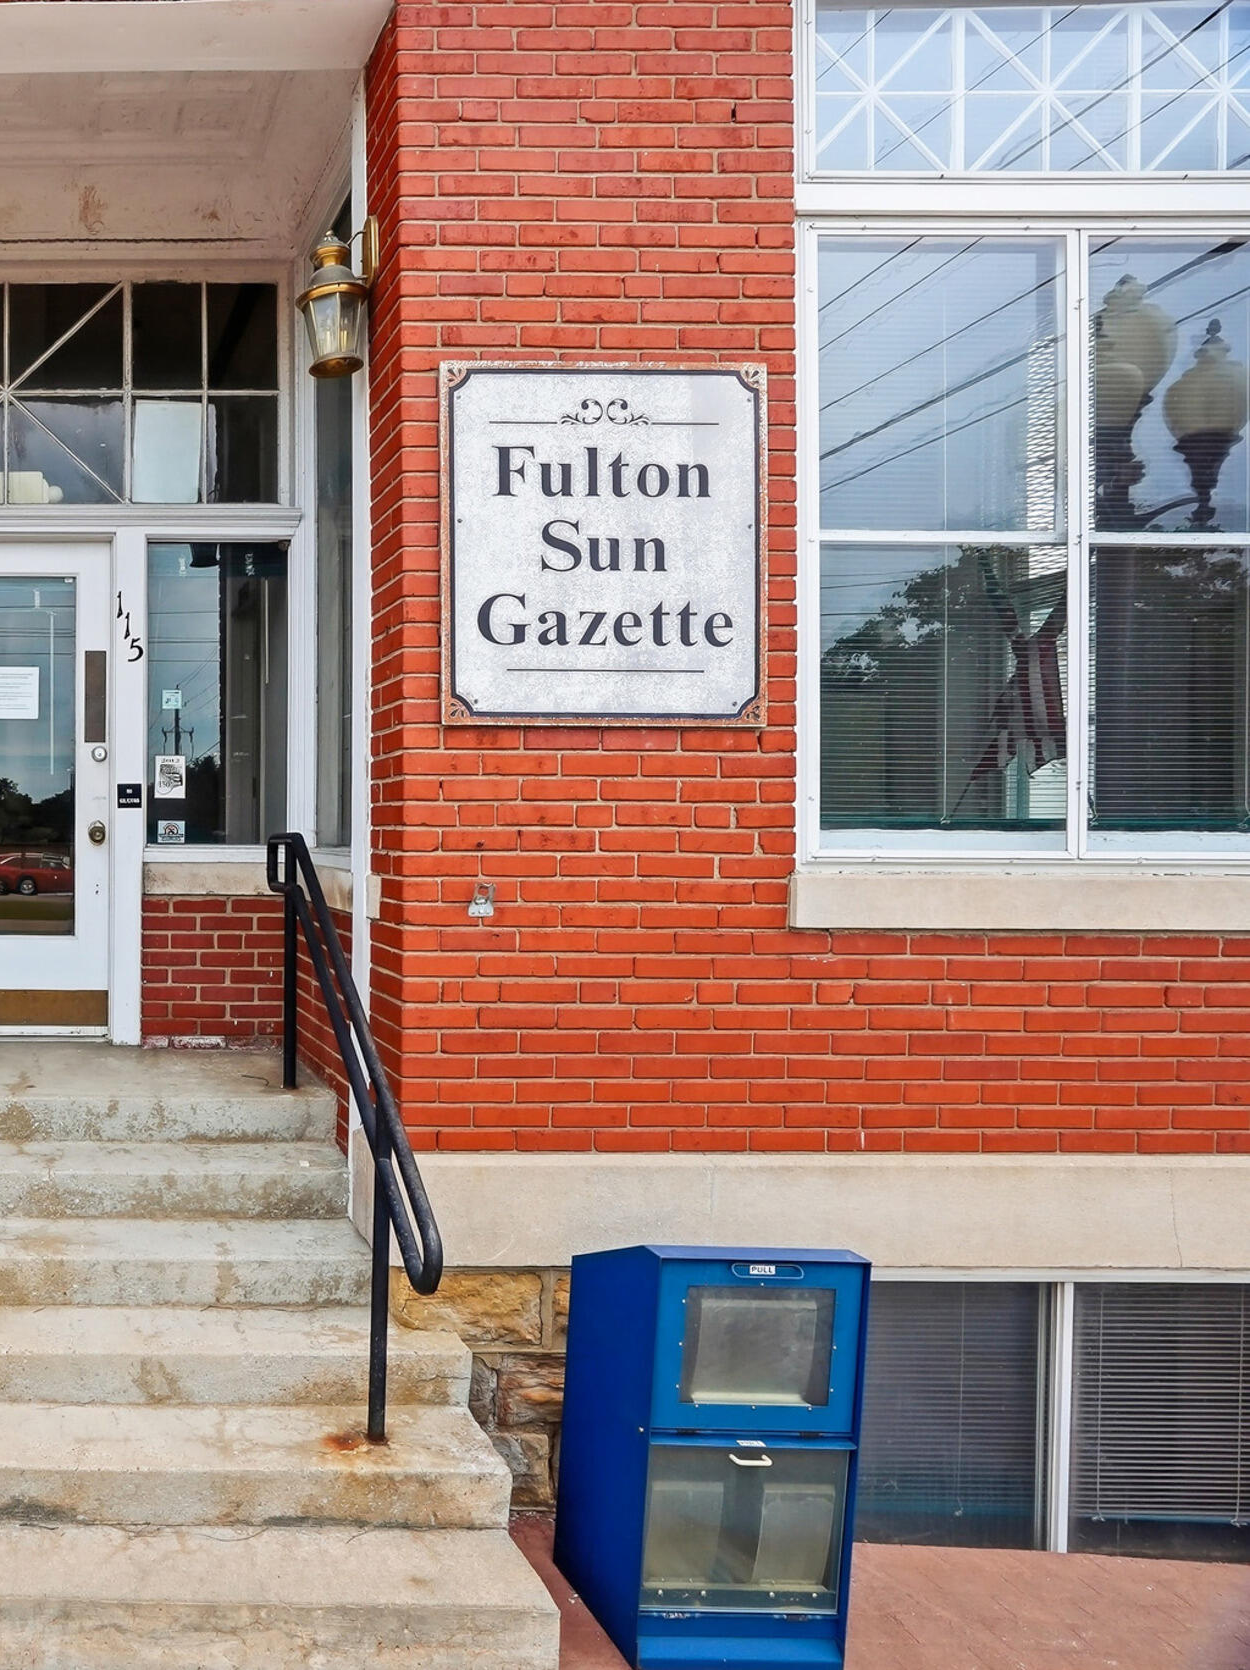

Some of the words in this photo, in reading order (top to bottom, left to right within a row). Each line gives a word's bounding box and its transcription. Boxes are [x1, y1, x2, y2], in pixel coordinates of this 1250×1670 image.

[491, 445, 711, 498] Fulton
[540, 519, 668, 573] Sun
[116, 590, 144, 662] 115
[476, 593, 734, 648] Gazette
[751, 1265, 773, 1274] PULL
